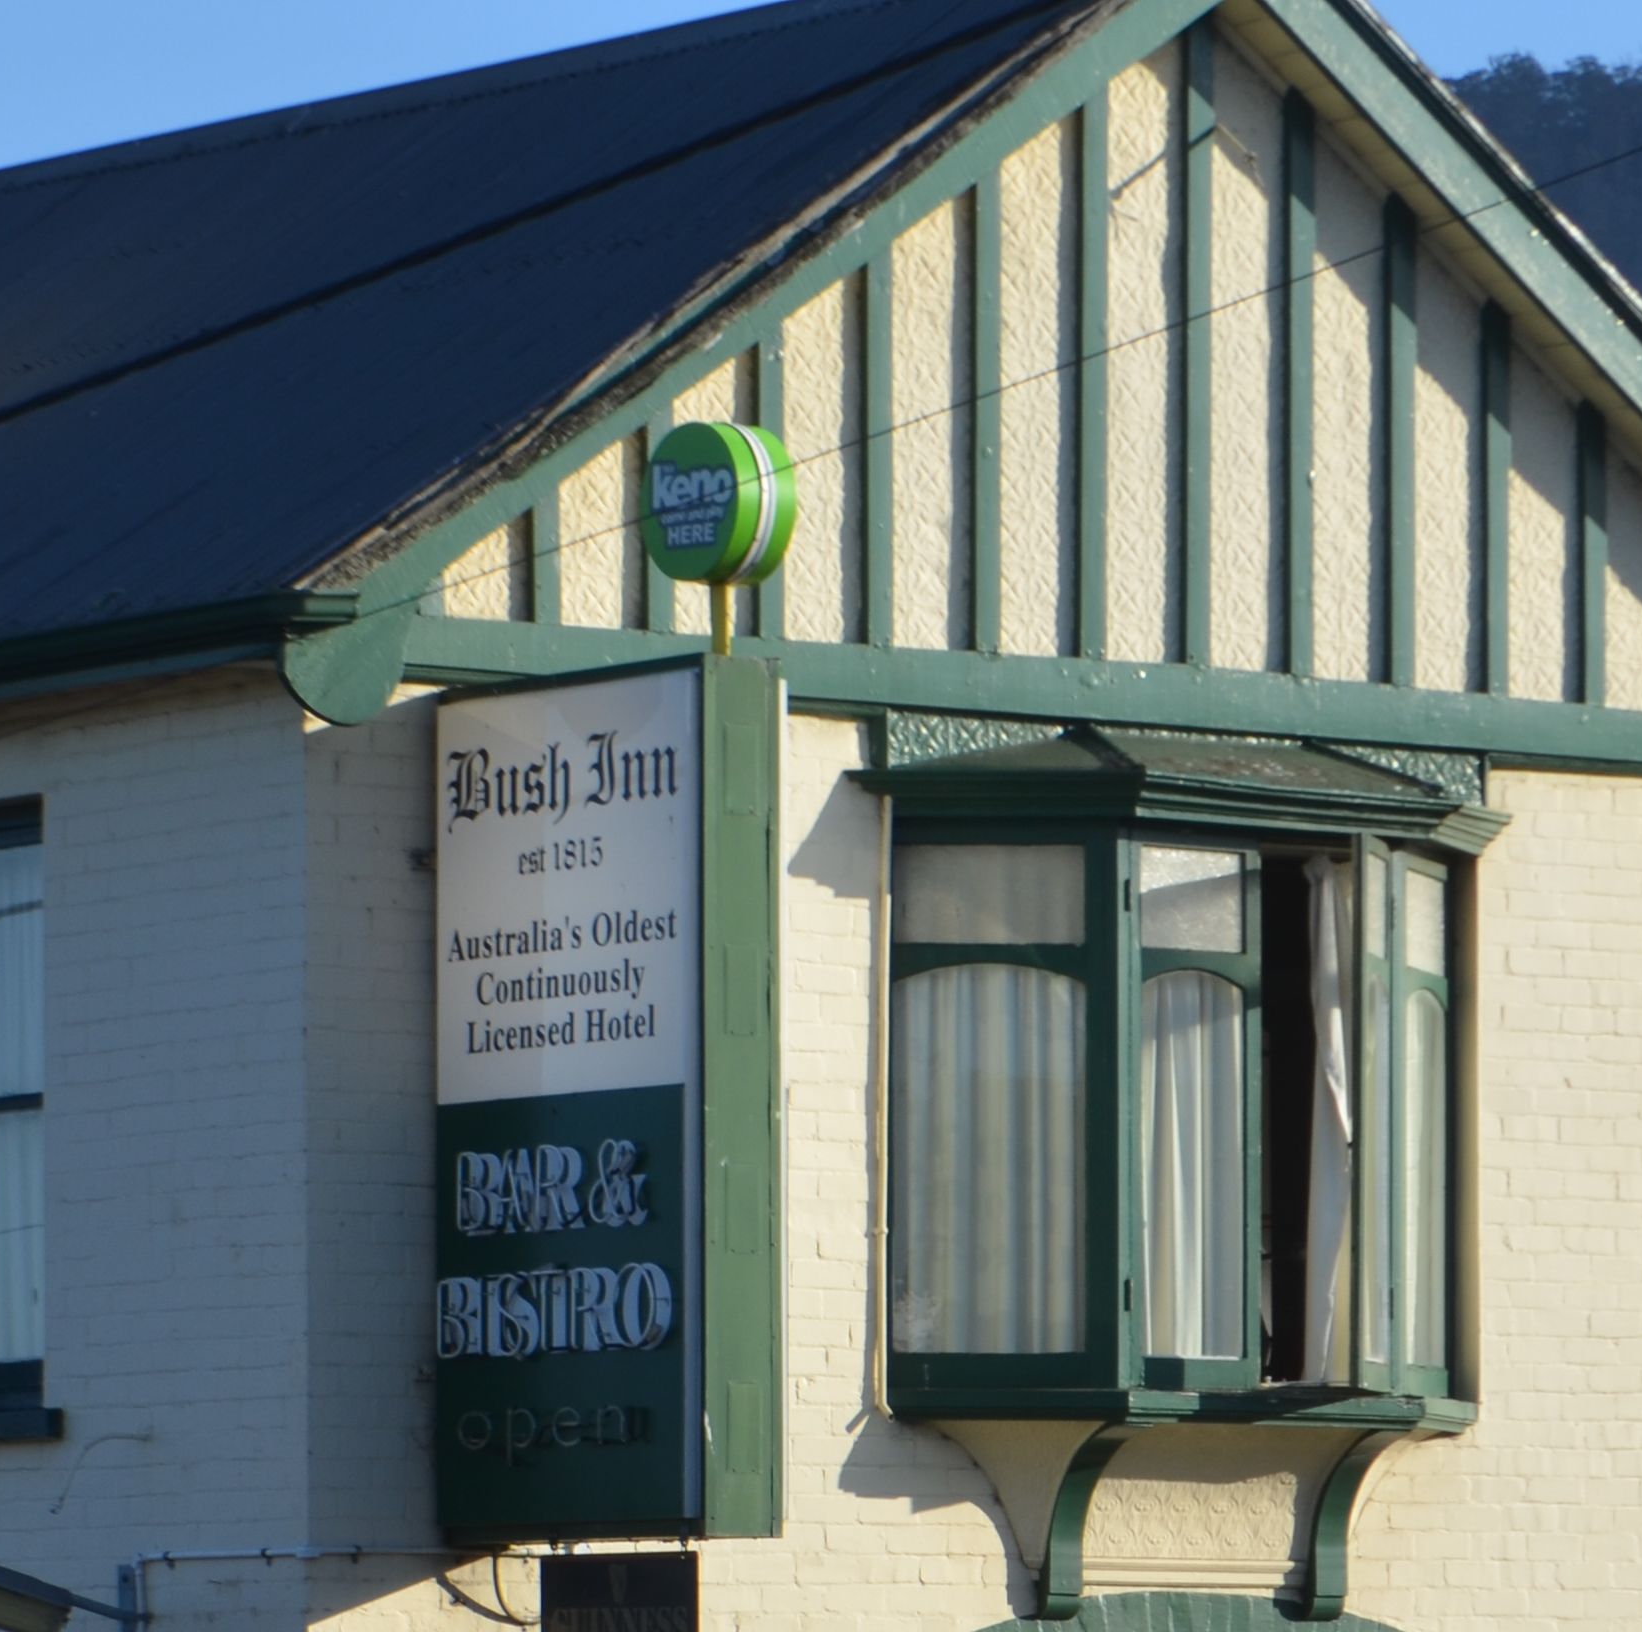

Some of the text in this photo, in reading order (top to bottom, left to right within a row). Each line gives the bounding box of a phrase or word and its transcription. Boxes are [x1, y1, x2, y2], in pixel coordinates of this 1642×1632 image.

[667, 522, 715, 547] HERE
[447, 729, 679, 834] Bush Inn
[518, 837, 605, 876] est 1815
[447, 908, 678, 962] Australia's Oldest
[476, 958, 646, 1006] Continuously
[467, 1004, 657, 1055] Licensed Hotel
[457, 1138, 648, 1236] BAR &
[437, 1262, 673, 1360] BISTRO
